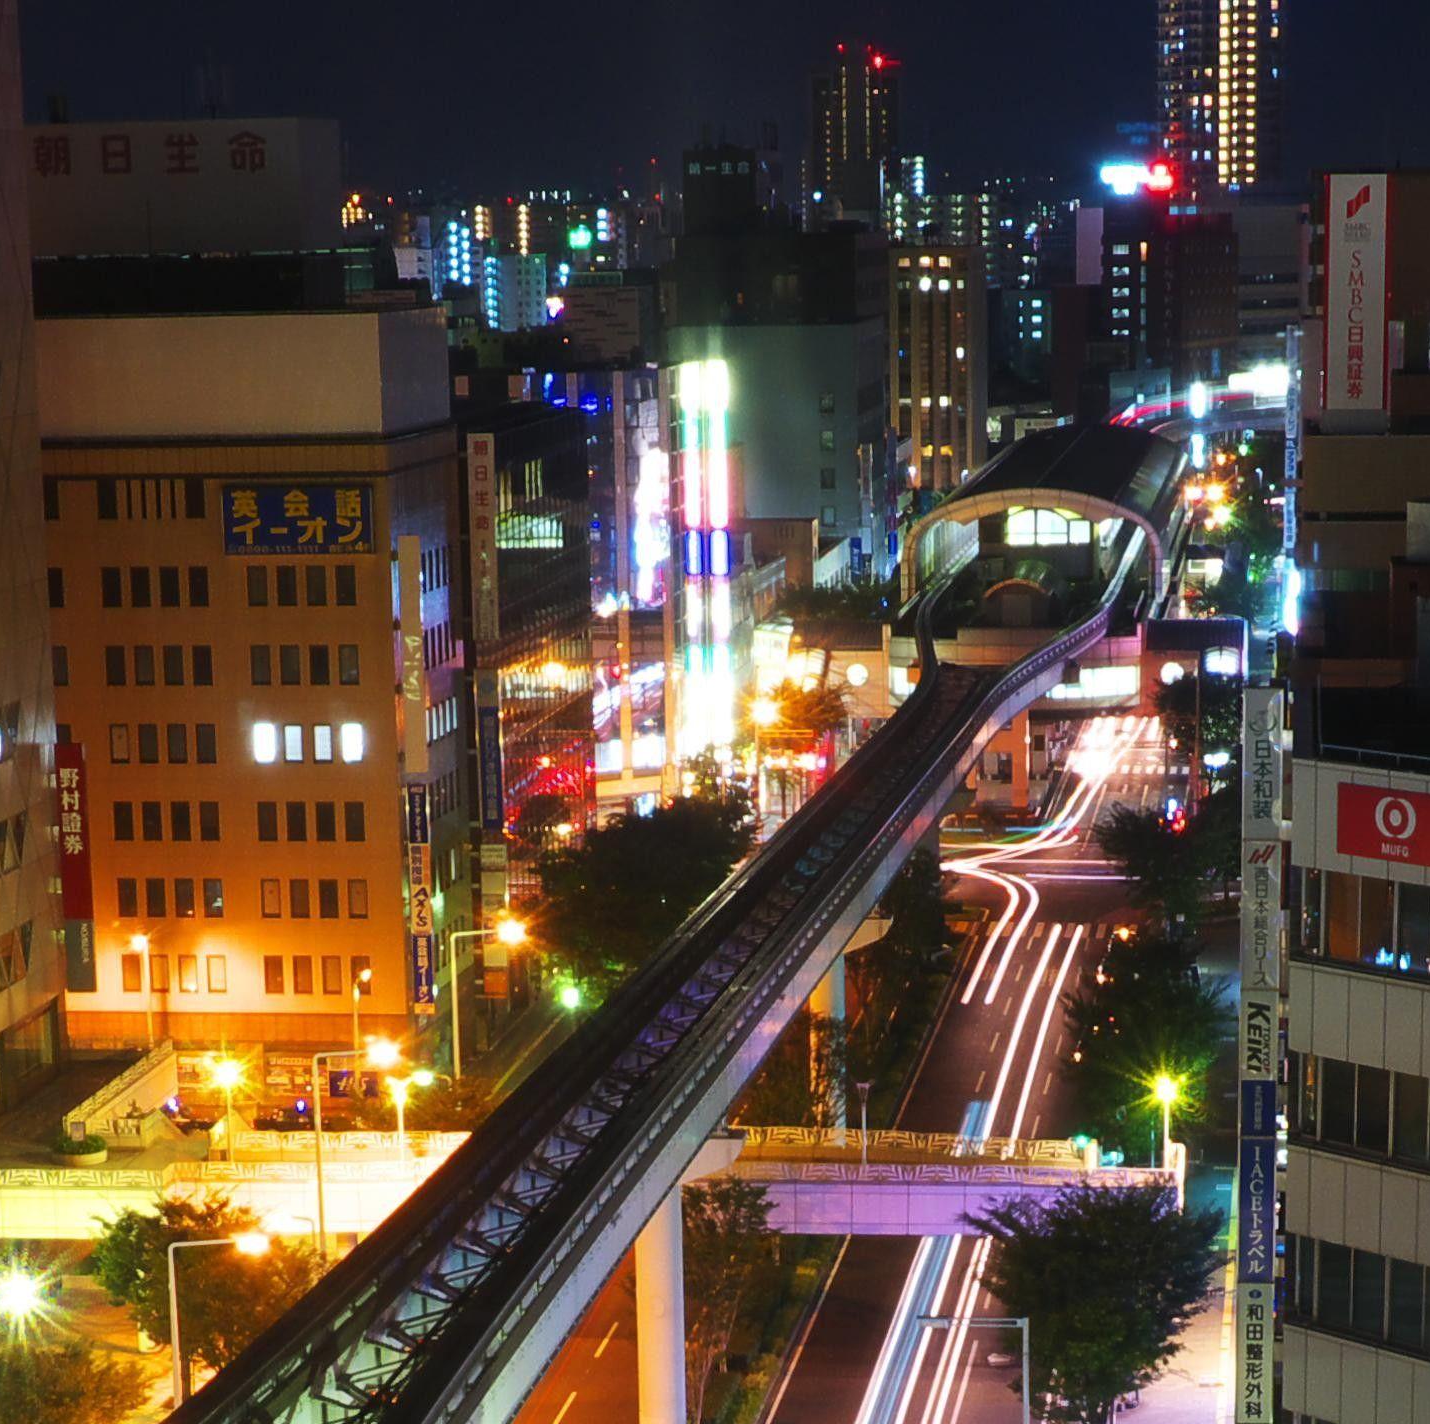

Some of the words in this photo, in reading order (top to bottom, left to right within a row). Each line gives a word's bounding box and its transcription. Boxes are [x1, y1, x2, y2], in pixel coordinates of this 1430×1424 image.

[32, 130, 268, 178] 朝日生命
[1346, 249, 1365, 400] SMBC日興証券
[230, 488, 363, 519] 英会話
[231, 516, 364, 545] イーオン
[58, 767, 84, 856] 野村證券
[1253, 738, 1274, 820] 日本和装
[1380, 842, 1410, 858] MUFG
[1252, 866, 1270, 988] 西日本総合リース
[1246, 1001, 1273, 1074] KEIKI
[1247, 1145, 1266, 1275] IACEトラベル
[1244, 1303, 1264, 1419] 和田整形外科
